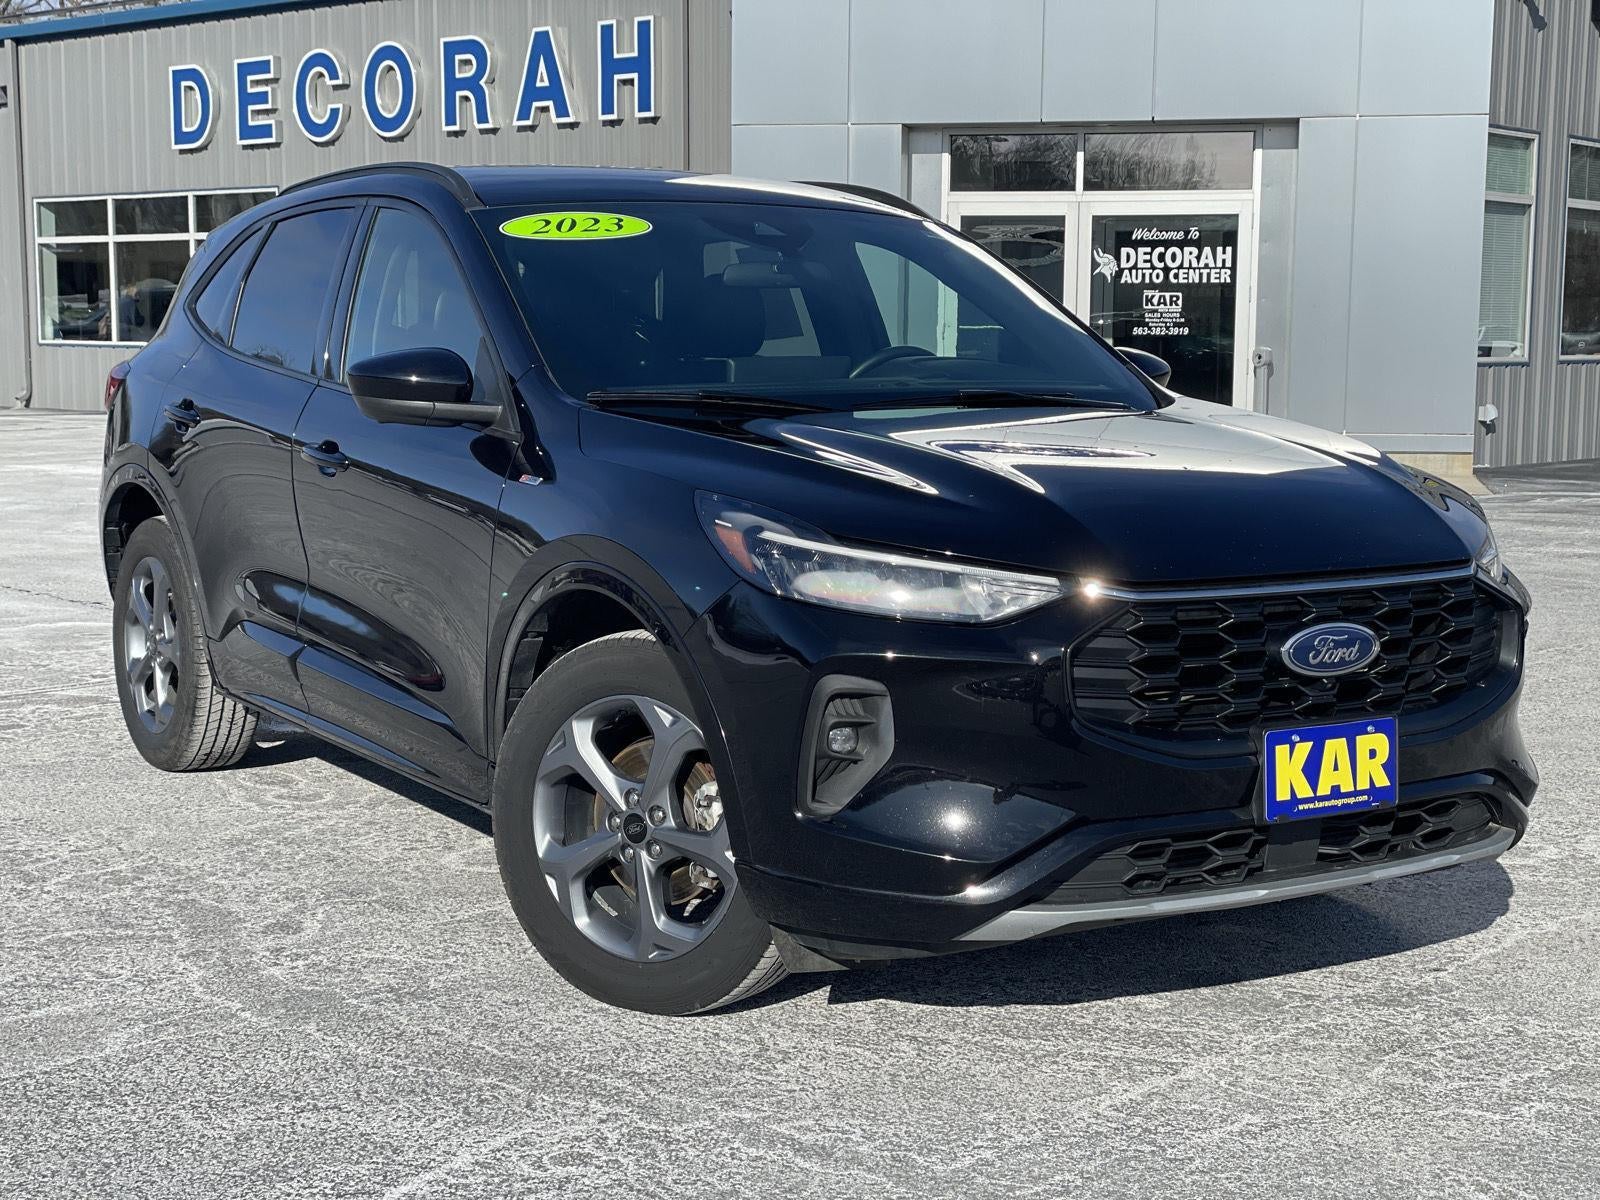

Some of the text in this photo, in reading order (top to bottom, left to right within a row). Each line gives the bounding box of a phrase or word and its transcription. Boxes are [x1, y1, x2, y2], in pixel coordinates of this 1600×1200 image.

[168, 14, 656, 151] DECORAH
[531, 217, 624, 235] 2023
[1132, 227, 1199, 240] Welcome To
[1120, 246, 1232, 268] DECORAH
[1120, 269, 1231, 283] AUTO CENTER
[1144, 294, 1181, 307] KAR
[1132, 326, 1189, 335] 563-382-3919
[1308, 635, 1360, 665] Ford
[1275, 732, 1391, 802] KAR
[1298, 794, 1368, 811] www.karautogroup.com
